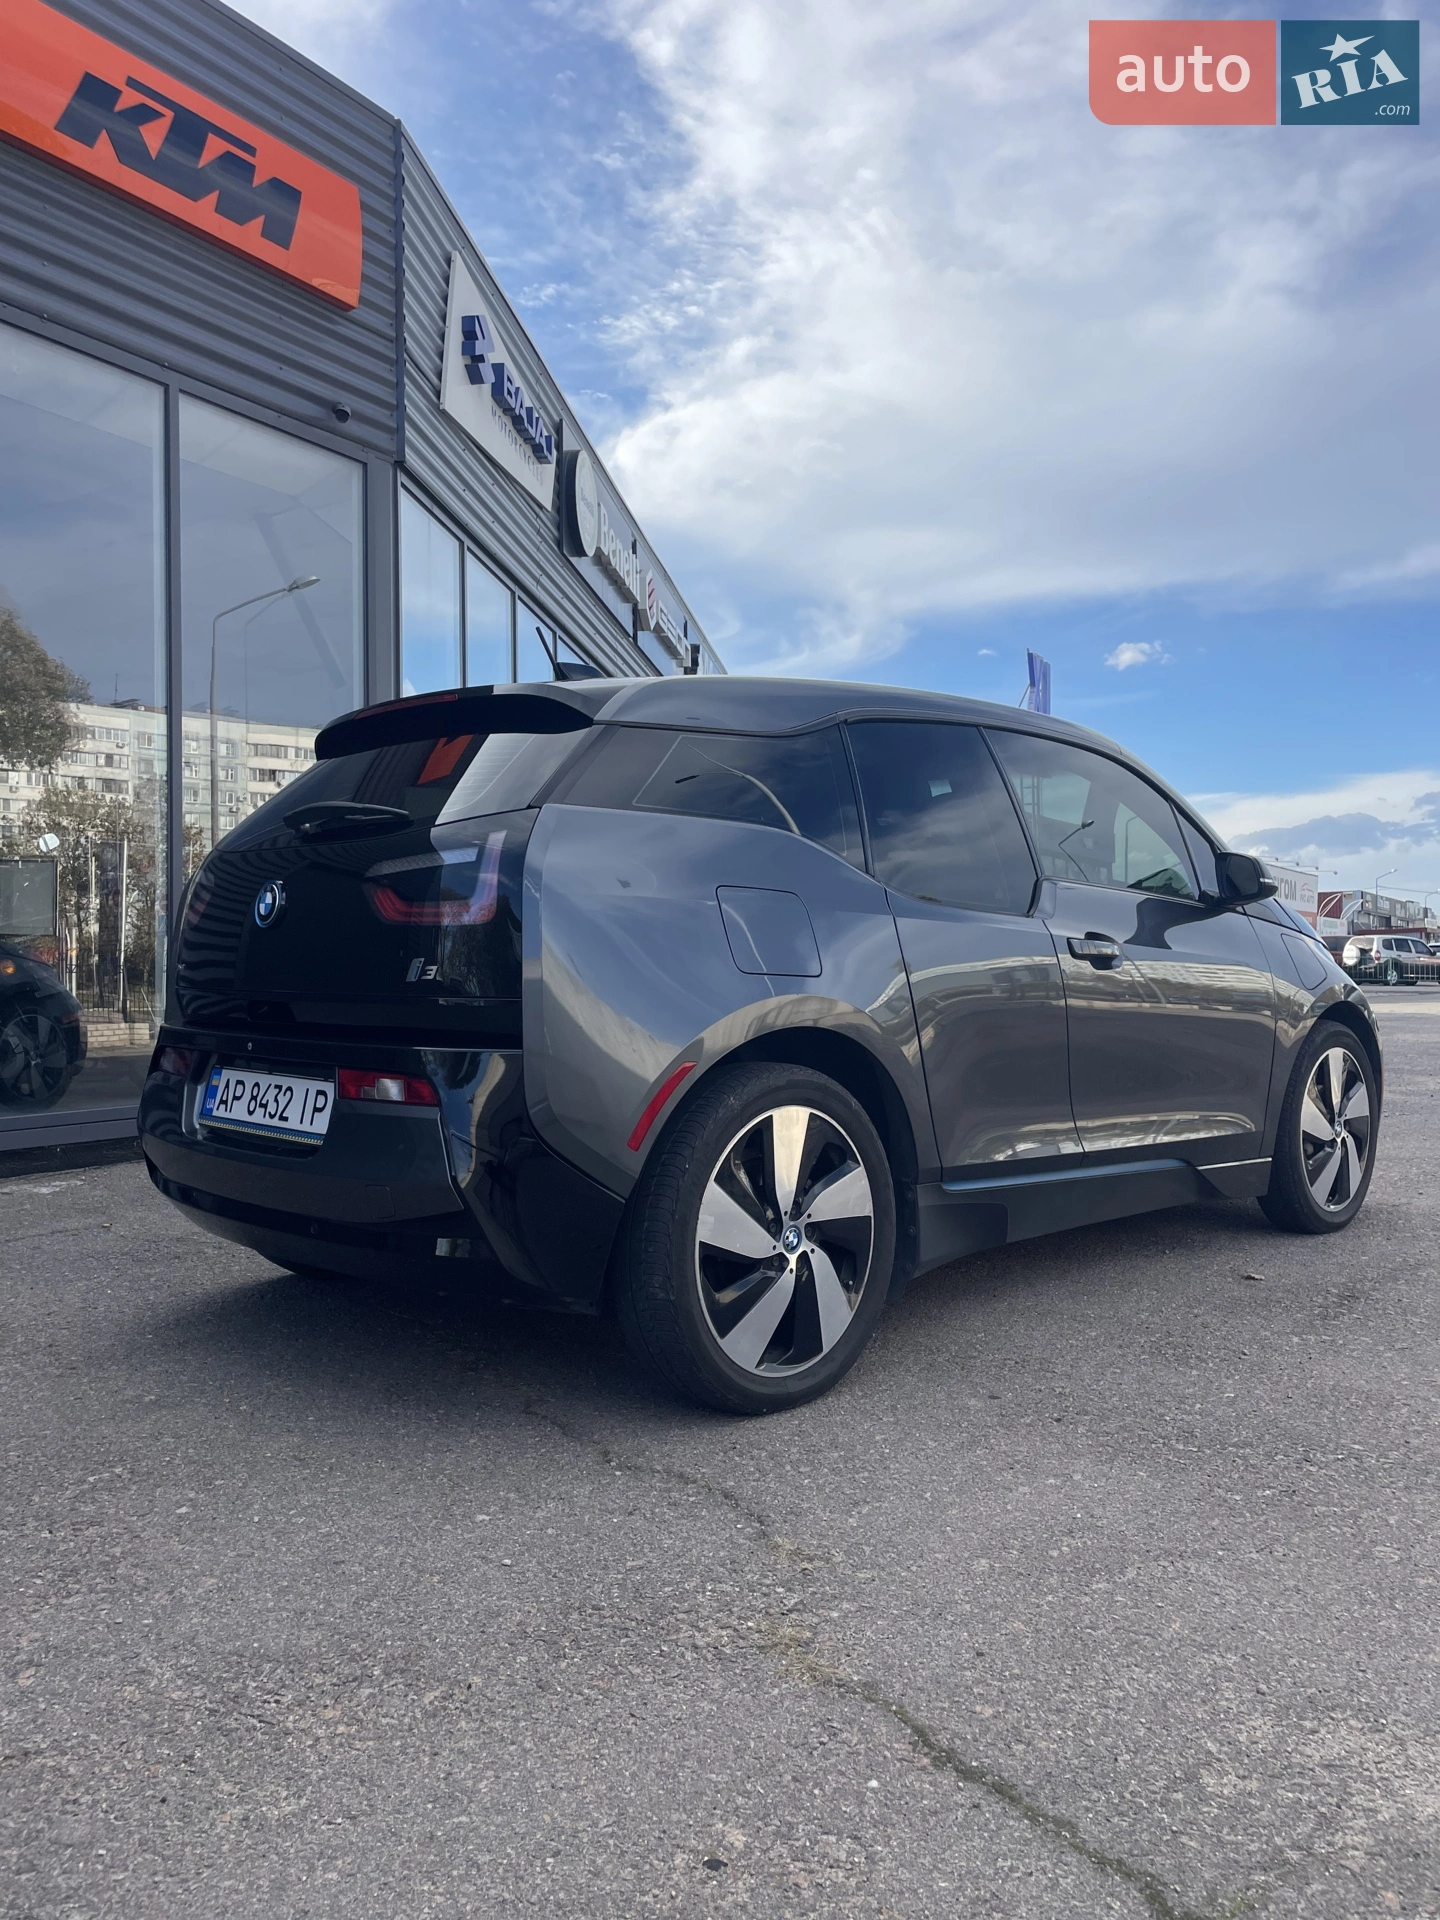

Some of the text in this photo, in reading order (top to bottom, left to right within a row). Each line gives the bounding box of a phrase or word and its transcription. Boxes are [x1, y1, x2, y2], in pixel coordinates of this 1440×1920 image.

[54, 71, 303, 251] KTM
[501, 362, 555, 465] BAJAJ
[405, 957, 439, 982] i3
[216, 1078, 329, 1126] AP 8432 IP
